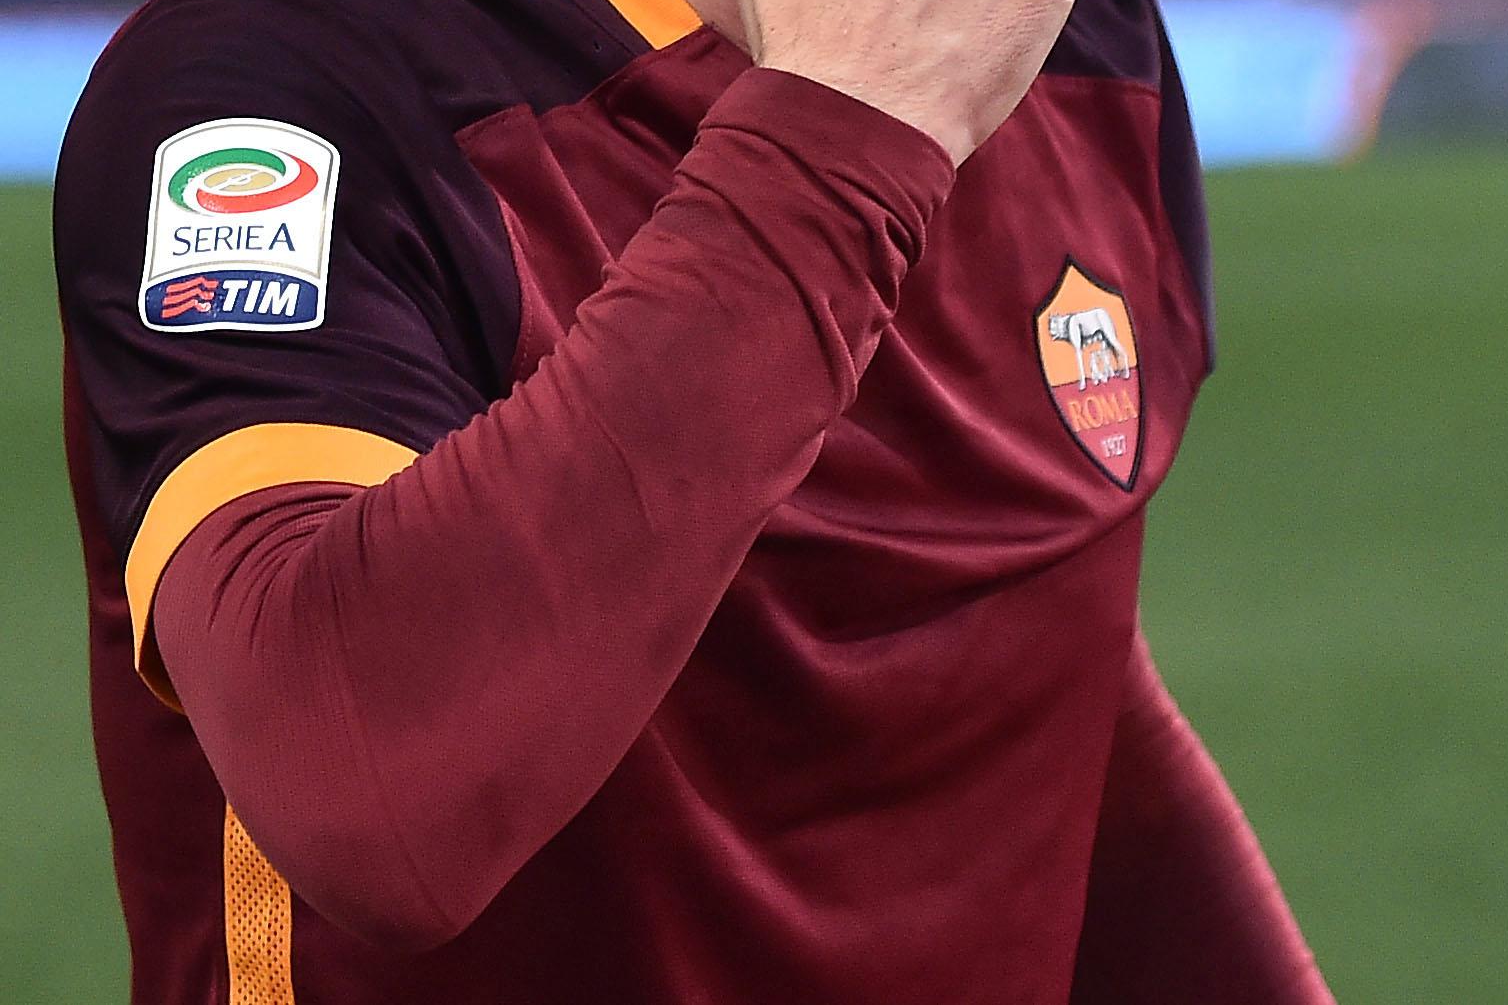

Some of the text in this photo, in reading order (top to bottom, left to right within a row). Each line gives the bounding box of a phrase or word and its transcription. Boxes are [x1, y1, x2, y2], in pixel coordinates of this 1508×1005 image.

[172, 222, 296, 256] SERIE A
[222, 280, 300, 317] TIM
[1068, 389, 1138, 432] ROMA
